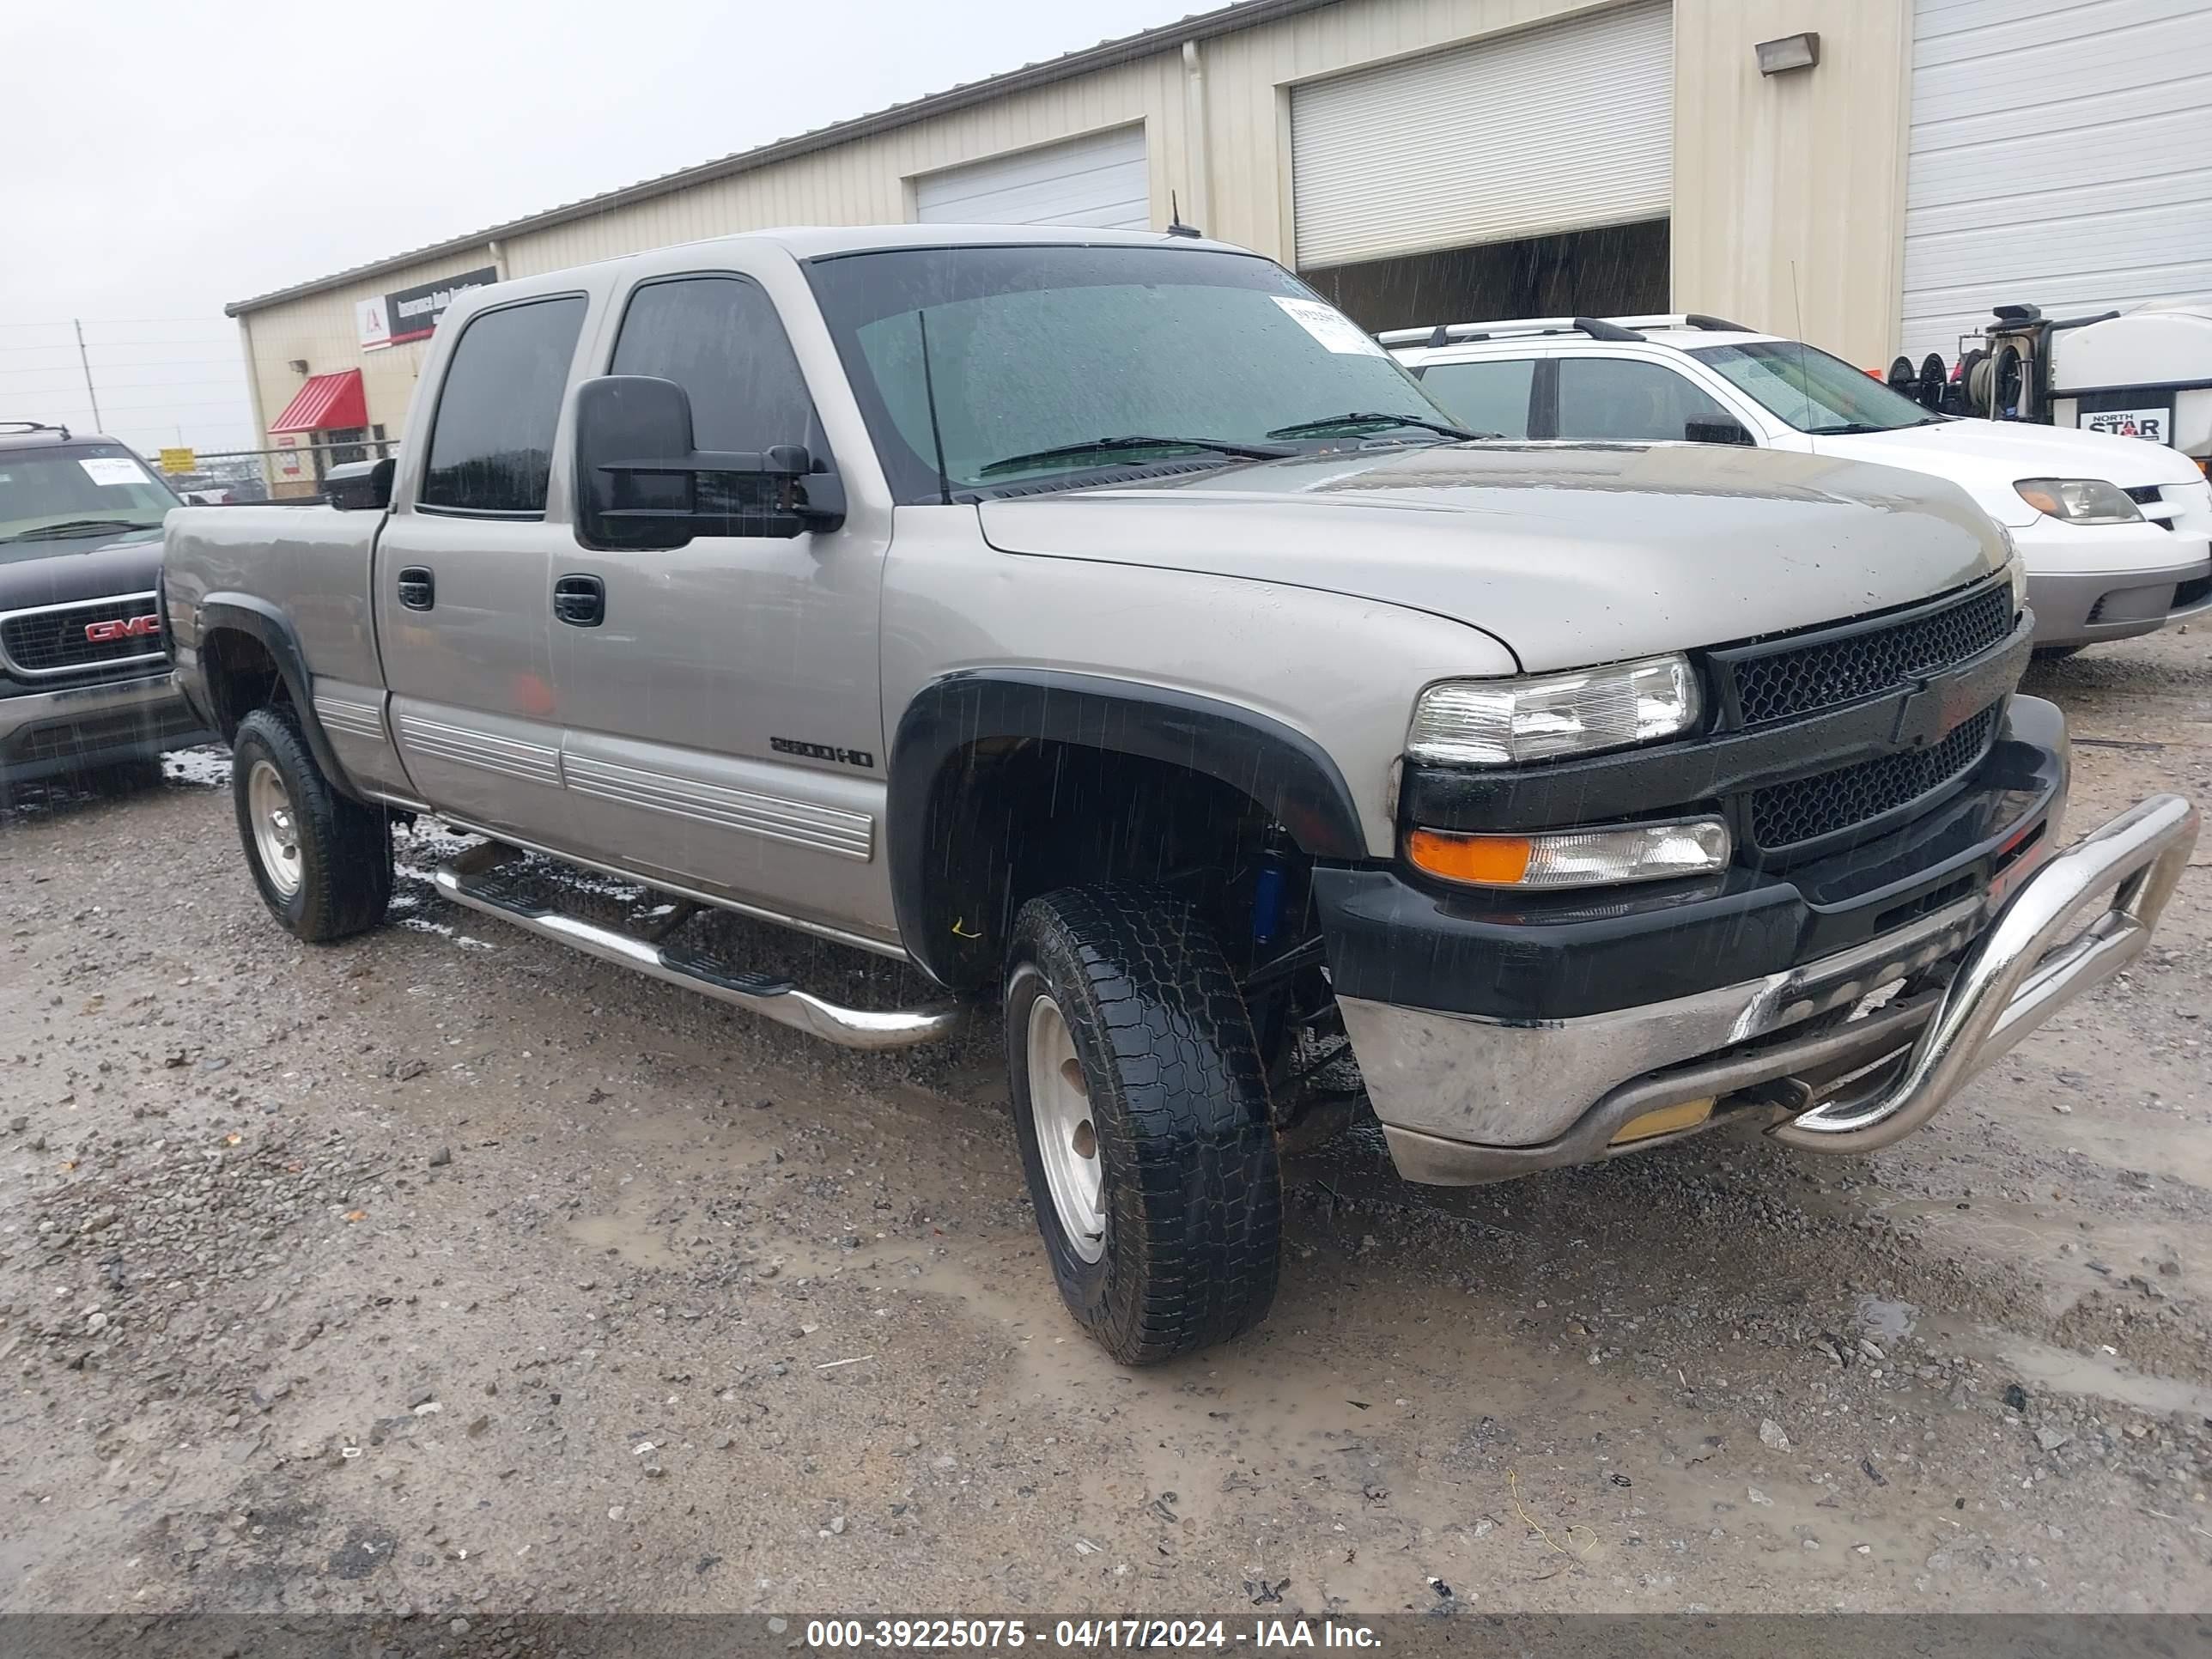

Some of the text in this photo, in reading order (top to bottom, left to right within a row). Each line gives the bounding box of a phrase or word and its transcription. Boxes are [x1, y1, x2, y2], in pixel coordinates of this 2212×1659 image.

[2093, 413, 2134, 422] NORTH
[2088, 419, 2160, 436] STAR
[85, 613, 161, 642] GMC
